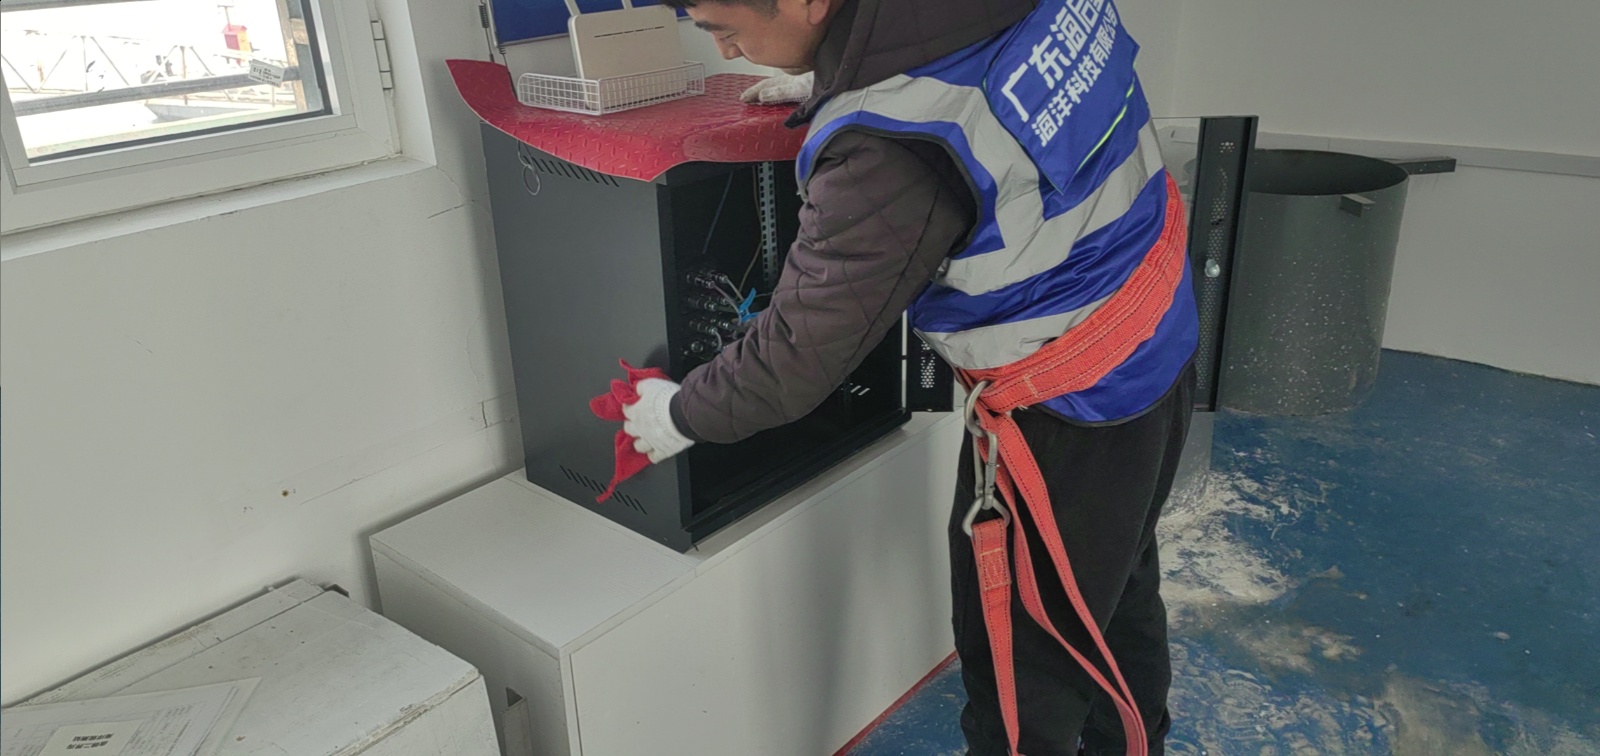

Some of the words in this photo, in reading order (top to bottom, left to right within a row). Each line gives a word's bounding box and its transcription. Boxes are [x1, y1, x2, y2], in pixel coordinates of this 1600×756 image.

[1031, 1, 1118, 147] 海洋科技有限公司
